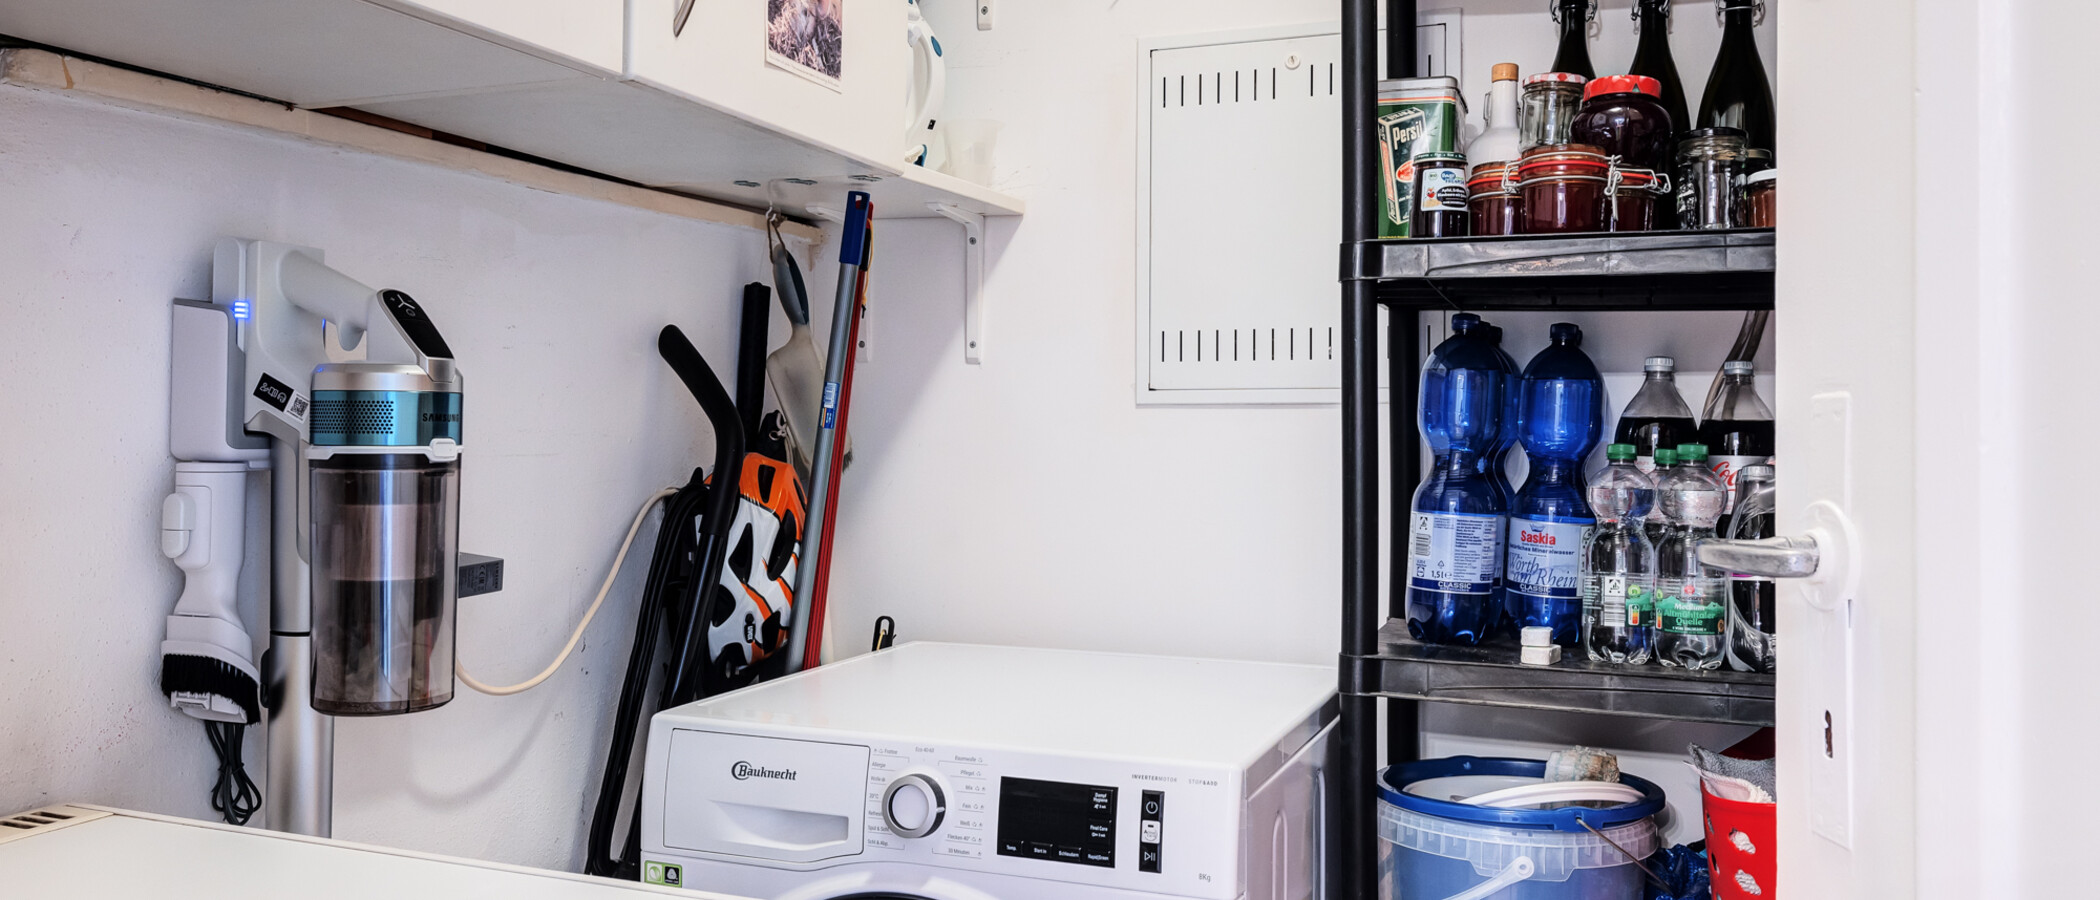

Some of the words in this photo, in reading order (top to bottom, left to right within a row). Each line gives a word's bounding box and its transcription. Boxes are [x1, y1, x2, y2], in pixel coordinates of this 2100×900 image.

[1392, 120, 1422, 150] Persil
[422, 413, 460, 422] SAMSUNG
[1521, 530, 1556, 545] Saskia
[1535, 568, 1577, 587] Rhein
[1438, 580, 1472, 589] CLASSIC
[1520, 584, 1551, 593] CLASSIC
[1674, 602, 1705, 611] Medium
[1676, 618, 1703, 626] Quelle
[731, 760, 797, 781] Bauknecht
[1132, 774, 1178, 782] INVERTERMOTOR
